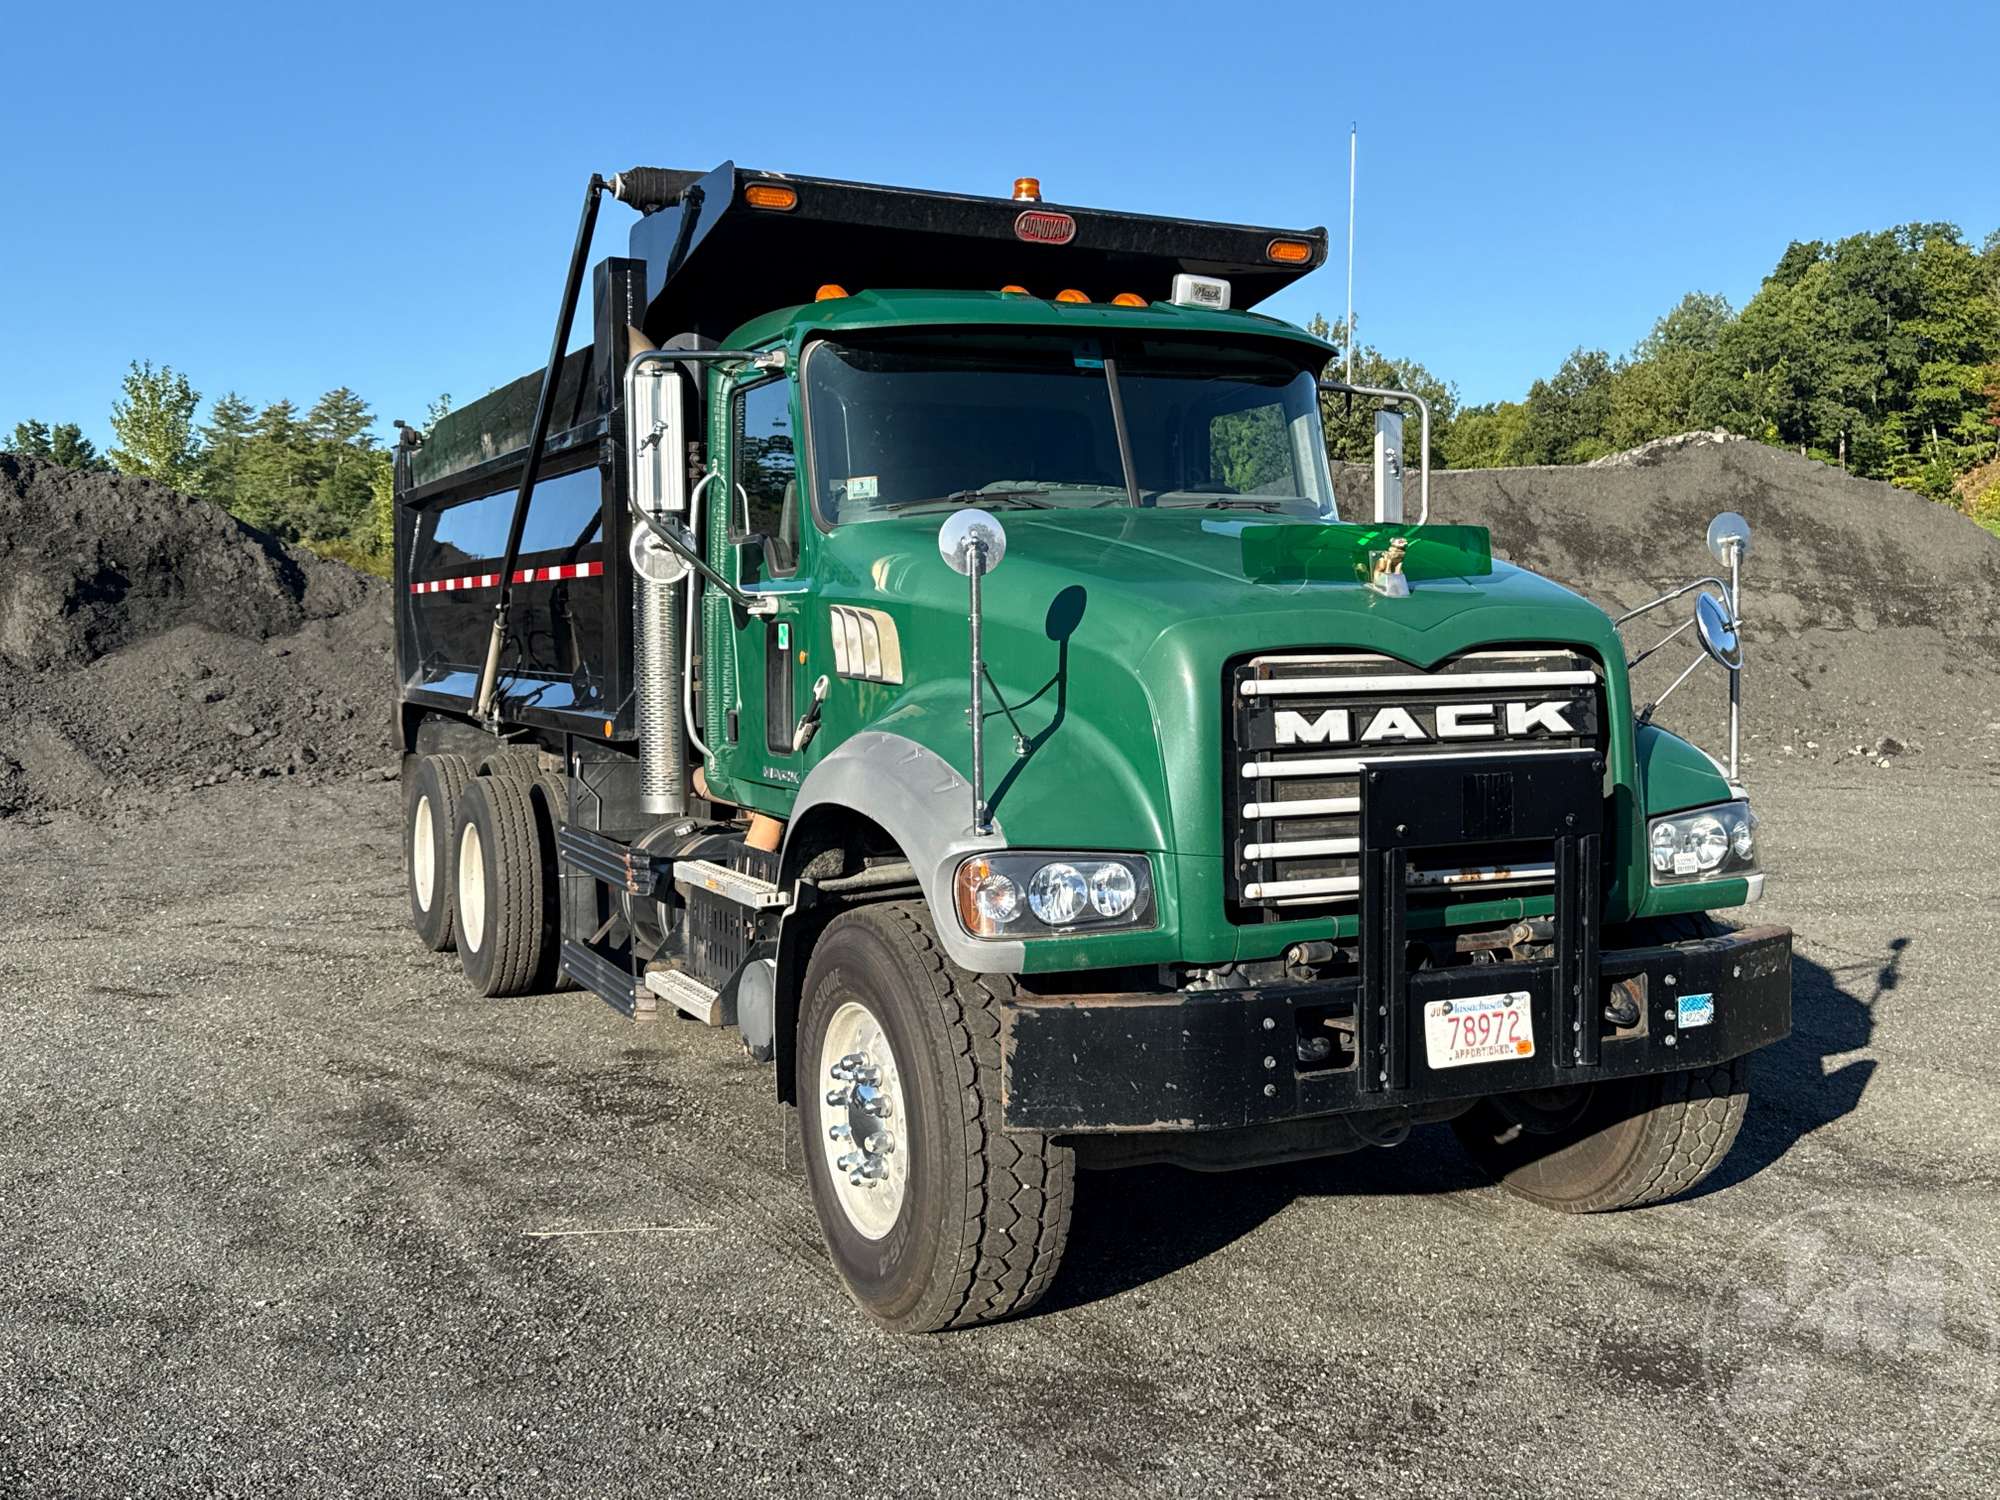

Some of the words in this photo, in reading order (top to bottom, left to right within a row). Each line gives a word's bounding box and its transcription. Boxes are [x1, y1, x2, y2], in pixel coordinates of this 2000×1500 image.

[1019, 216, 1073, 238] DONOVAN
[1274, 700, 1574, 744] MACK
[1448, 1010, 1521, 1050] 78972
[1455, 1044, 1510, 1060] APPORTIONED
